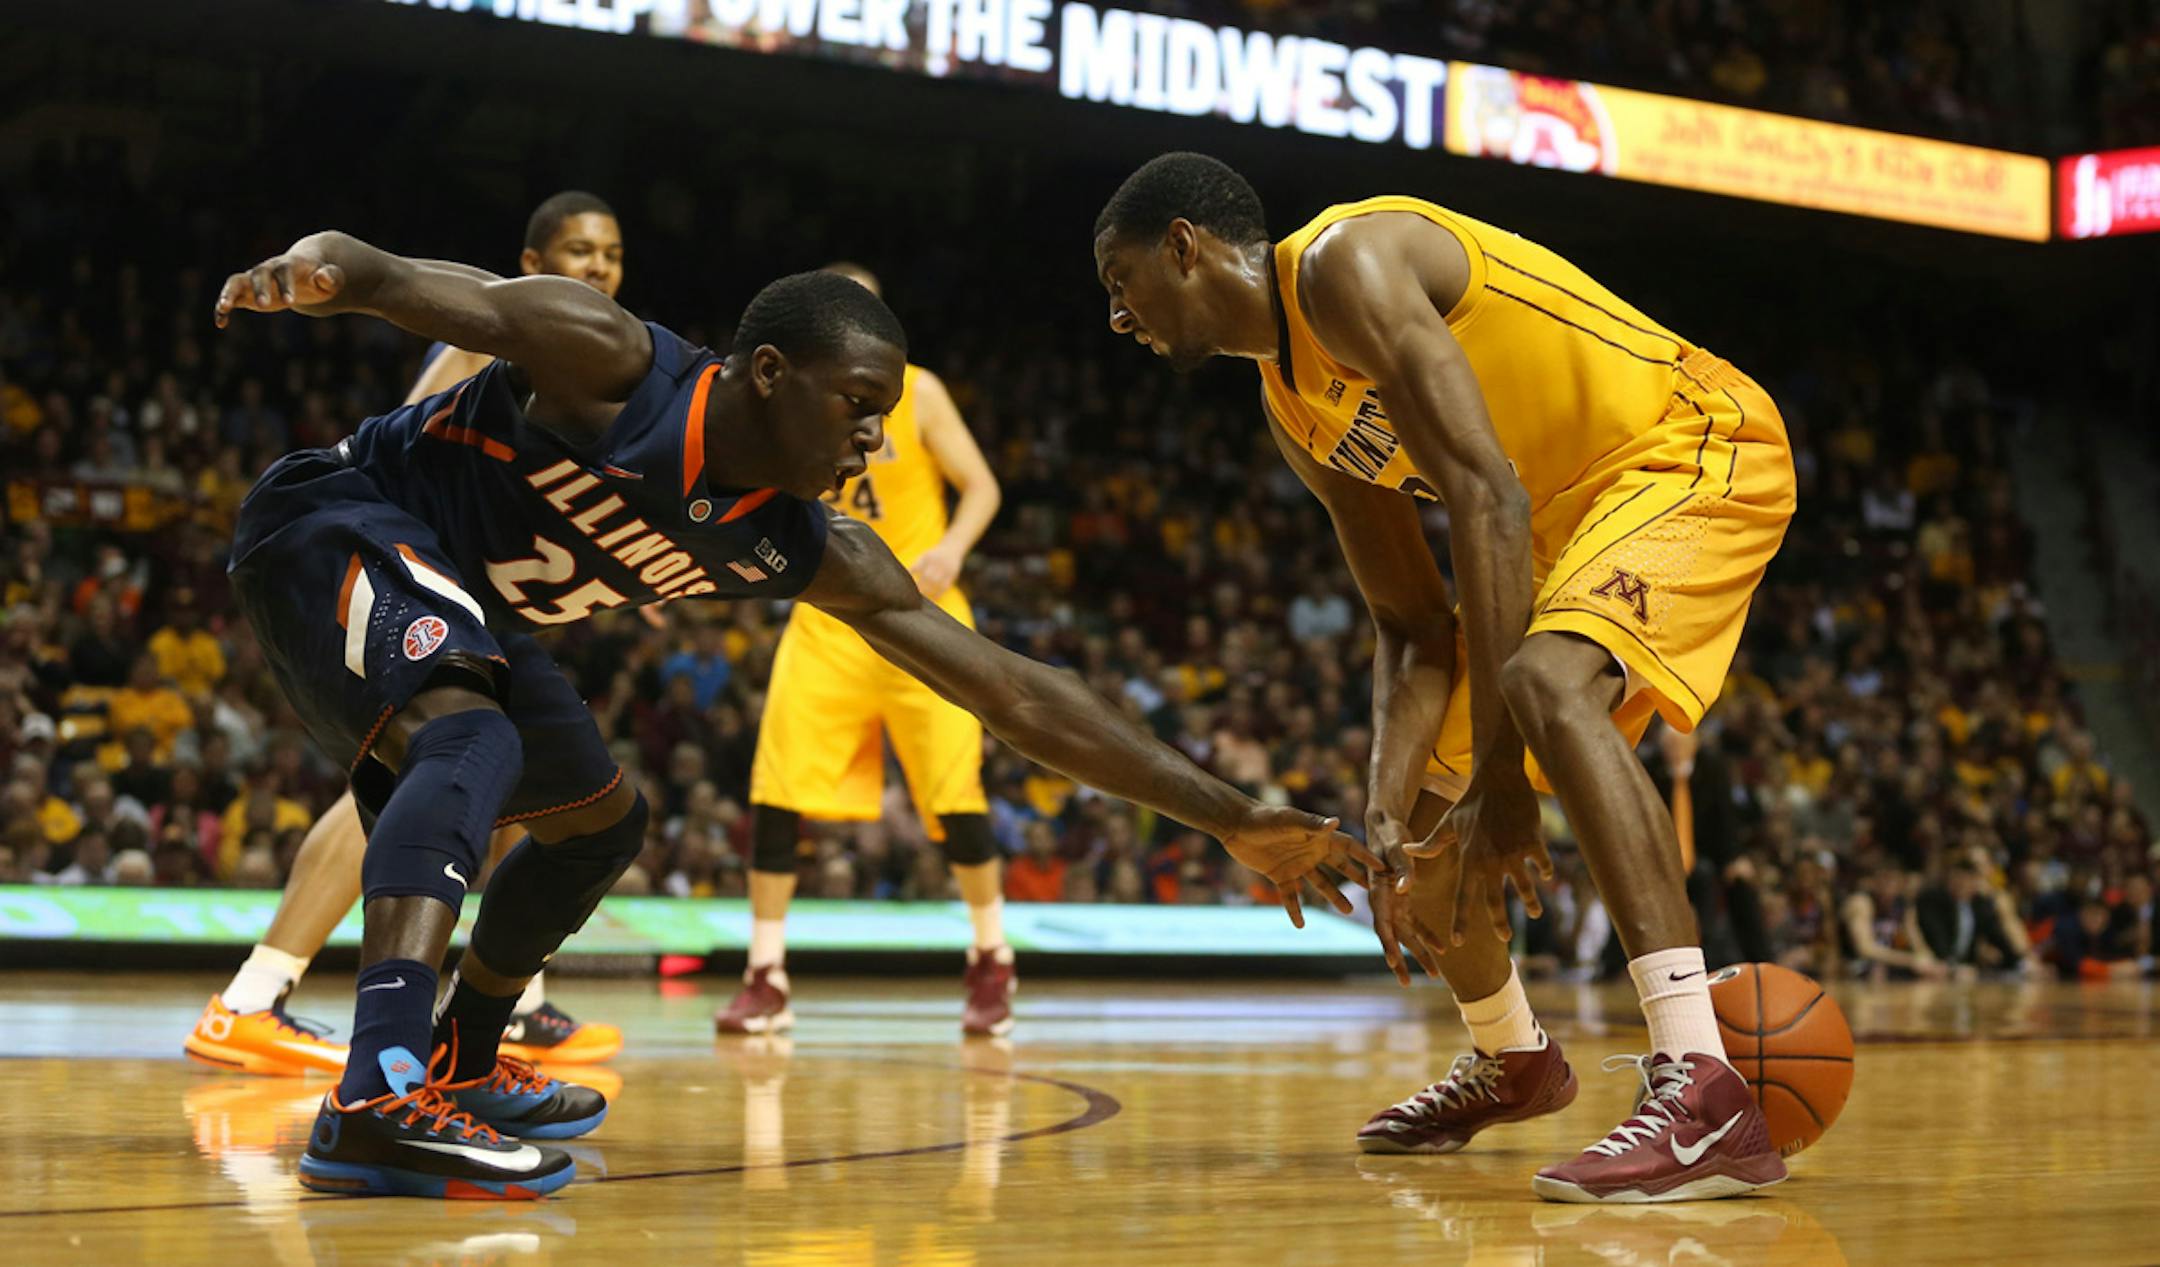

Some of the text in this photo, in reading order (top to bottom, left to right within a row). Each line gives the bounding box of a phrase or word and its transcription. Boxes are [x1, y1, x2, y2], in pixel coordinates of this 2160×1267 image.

[926, 0, 1052, 73] THE
[1059, 1, 1447, 150] MIDWEST
[483, 533, 630, 626] 25
[1589, 566, 1651, 625] M
